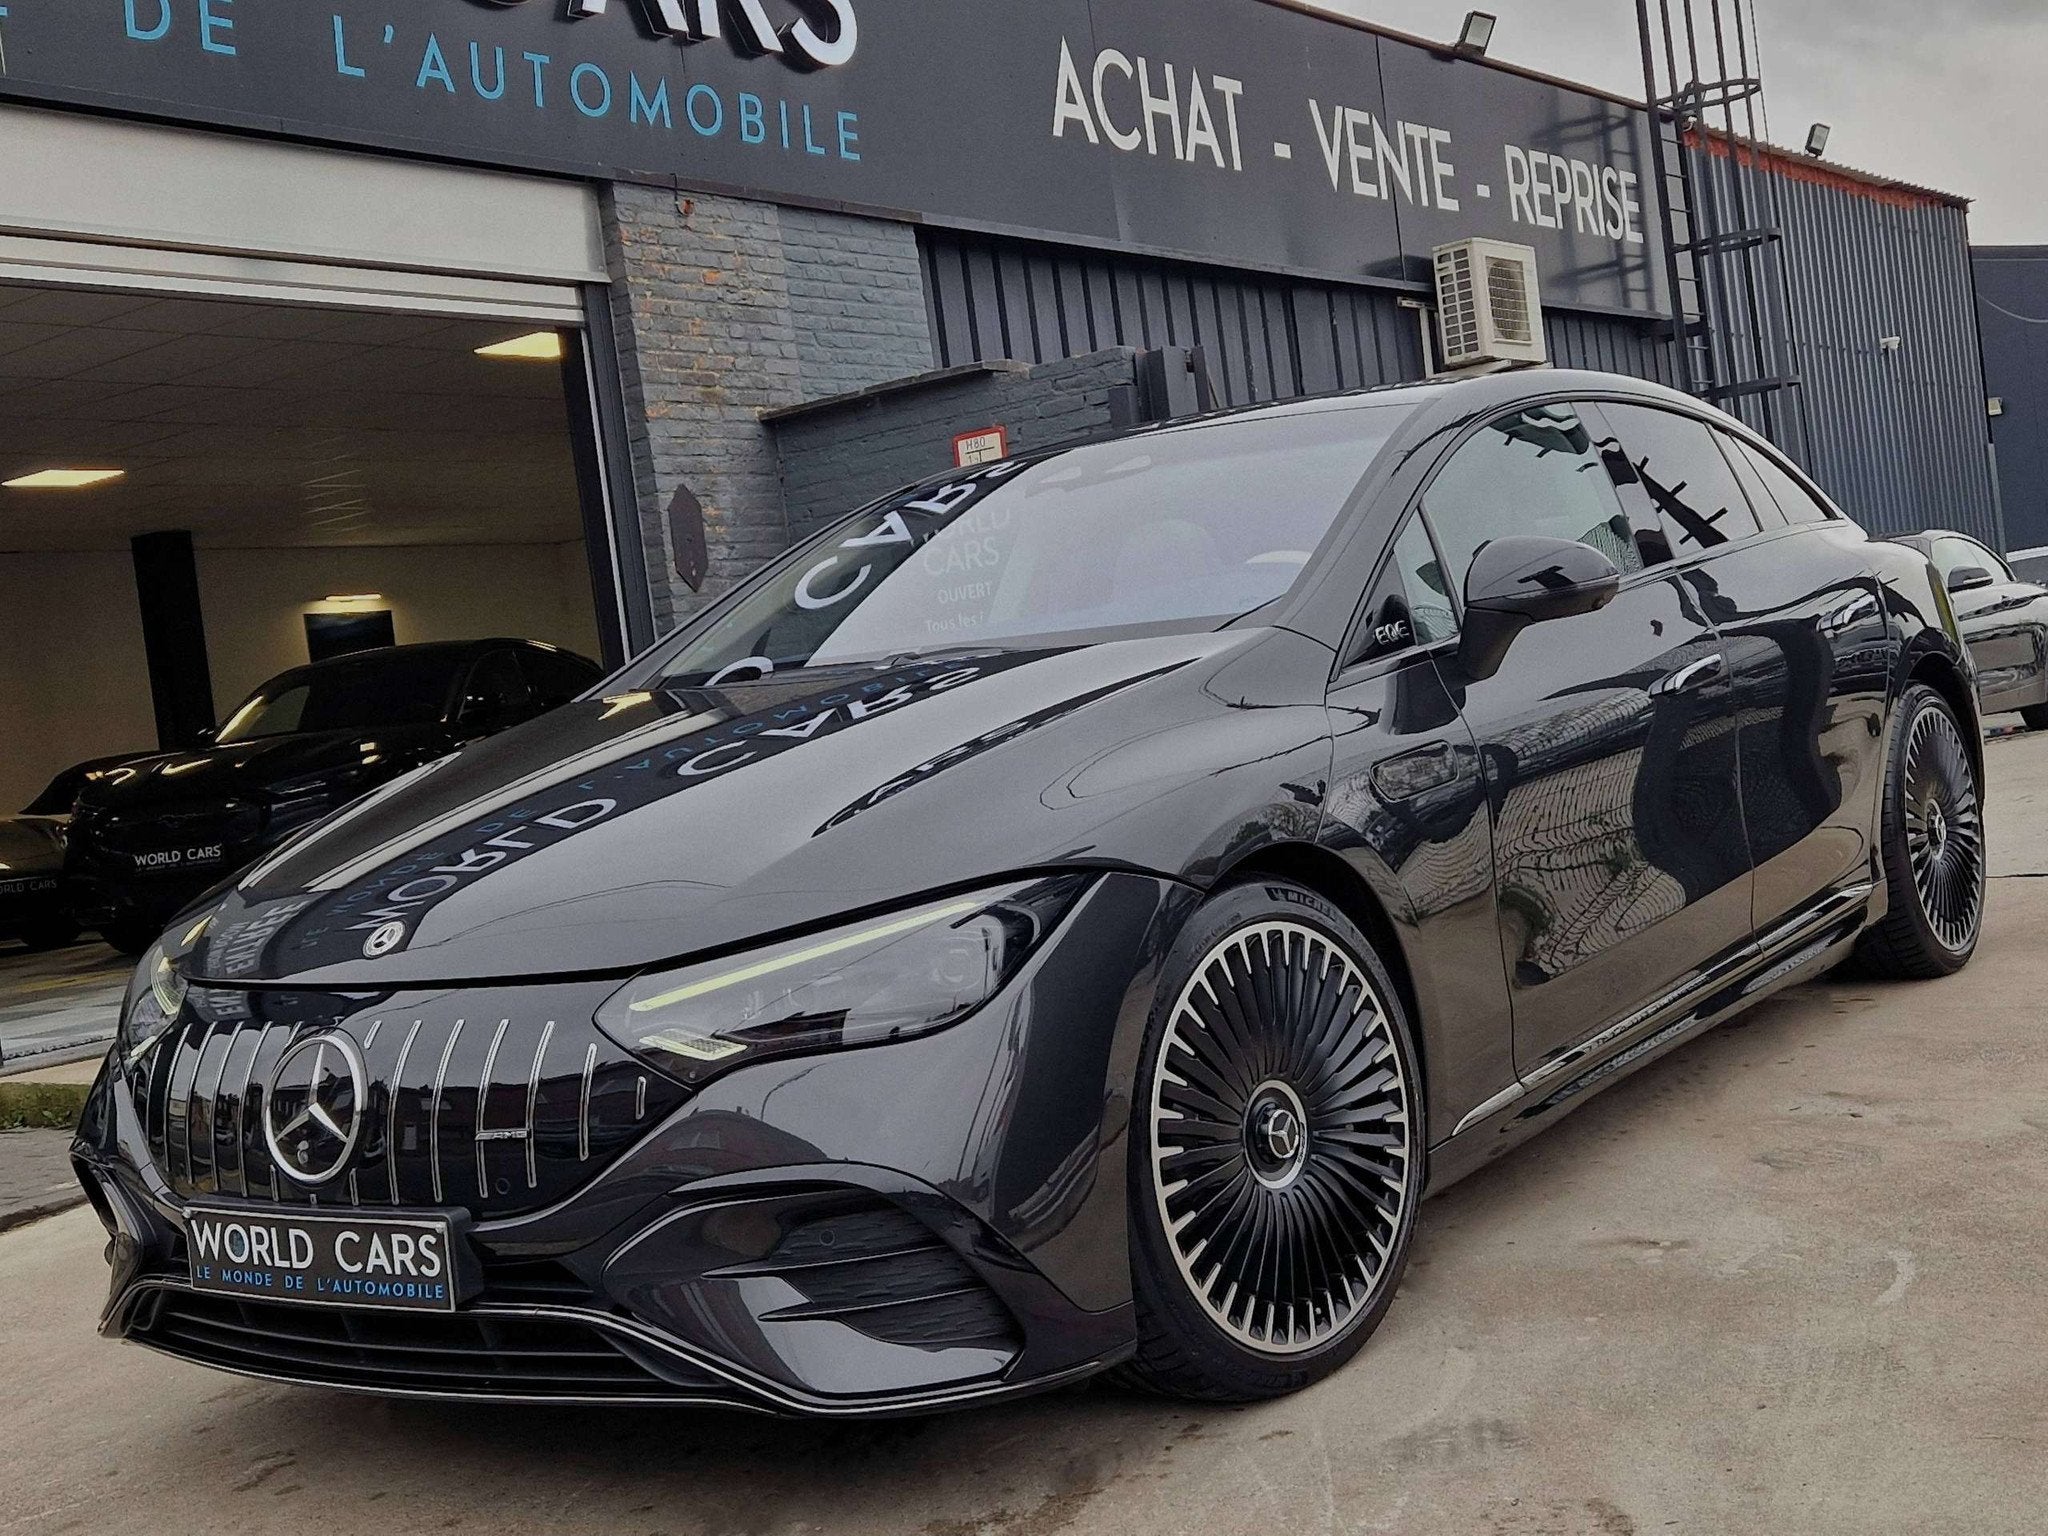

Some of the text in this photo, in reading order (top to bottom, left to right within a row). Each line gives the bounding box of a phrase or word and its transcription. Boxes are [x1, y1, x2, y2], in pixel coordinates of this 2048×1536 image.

[124, 0, 237, 56] DE
[333, 14, 861, 161] L'AUTOMOBILE
[1053, 36, 1243, 171] ACHAT
[1308, 98, 1460, 211] VENTE
[1505, 144, 1644, 243] REPRISE
[937, 581, 992, 604] OUVERT
[1375, 620, 1410, 645] EQE
[134, 851, 181, 866] WORLD
[187, 845, 222, 860] CARS
[190, 1219, 442, 1278] WORLD CARS
[196, 1266, 445, 1299] LE MONDE DE L'AUTOMOBILE
